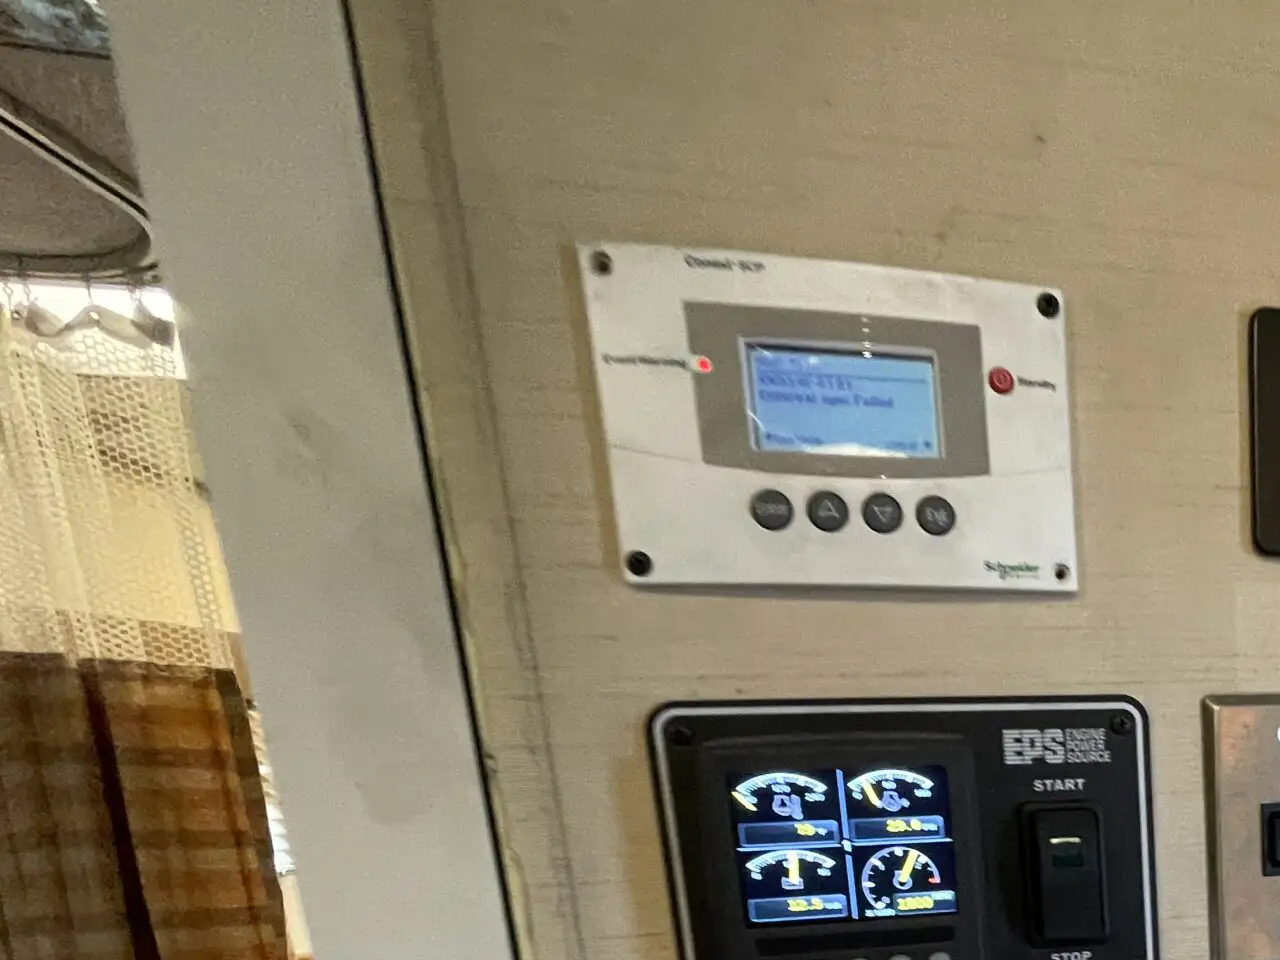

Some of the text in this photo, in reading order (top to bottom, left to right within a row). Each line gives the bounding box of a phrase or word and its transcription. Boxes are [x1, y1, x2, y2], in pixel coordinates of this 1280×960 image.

[1065, 728, 1106, 740] ENGINE
[1002, 728, 1065, 765] EPS
[1065, 740, 1105, 752] POWER
[1066, 751, 1112, 763] SOURCE
[1032, 778, 1086, 792] START
